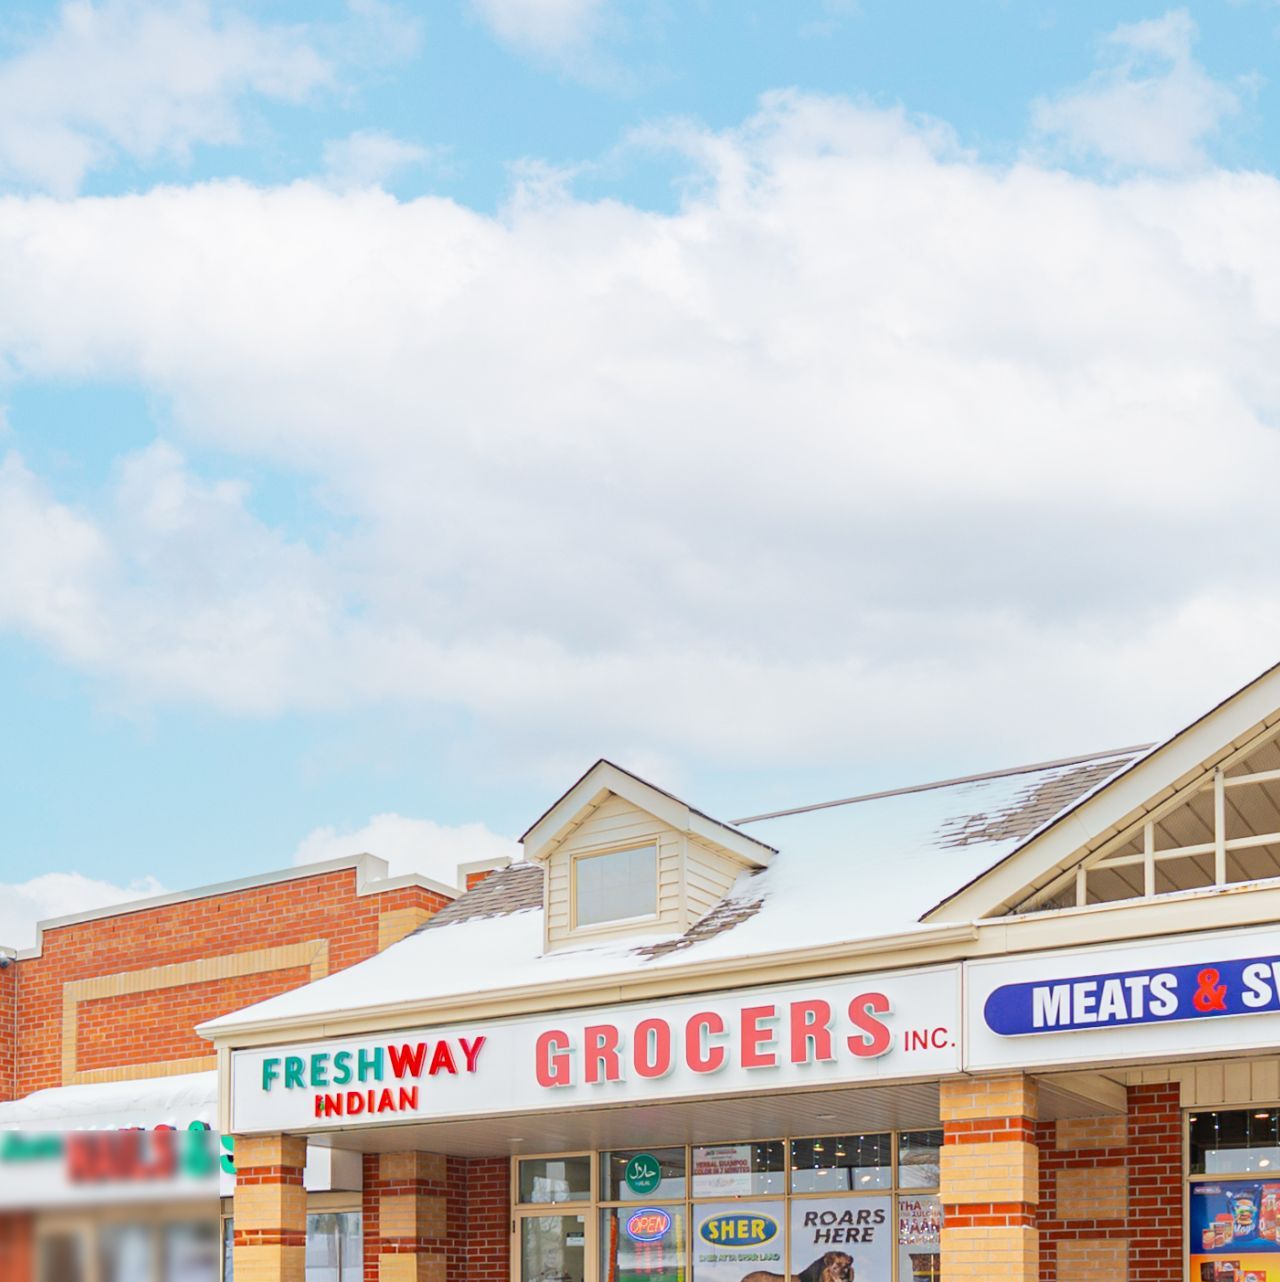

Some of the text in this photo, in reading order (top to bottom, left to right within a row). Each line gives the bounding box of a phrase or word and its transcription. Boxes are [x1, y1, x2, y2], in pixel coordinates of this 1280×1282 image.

[1032, 972, 1179, 1029] MEATS
[1192, 967, 1227, 1013] &
[535, 991, 957, 1090] GROCERS INC.
[261, 1035, 487, 1093] FRESHWAY
[314, 1085, 419, 1119] INDIAN
[629, 1162, 657, 1180] حلال
[629, 1215, 667, 1235] OPEN
[804, 1209, 886, 1227] ROARS
[708, 1219, 766, 1240] SHER
[814, 1227, 875, 1244] HERE
